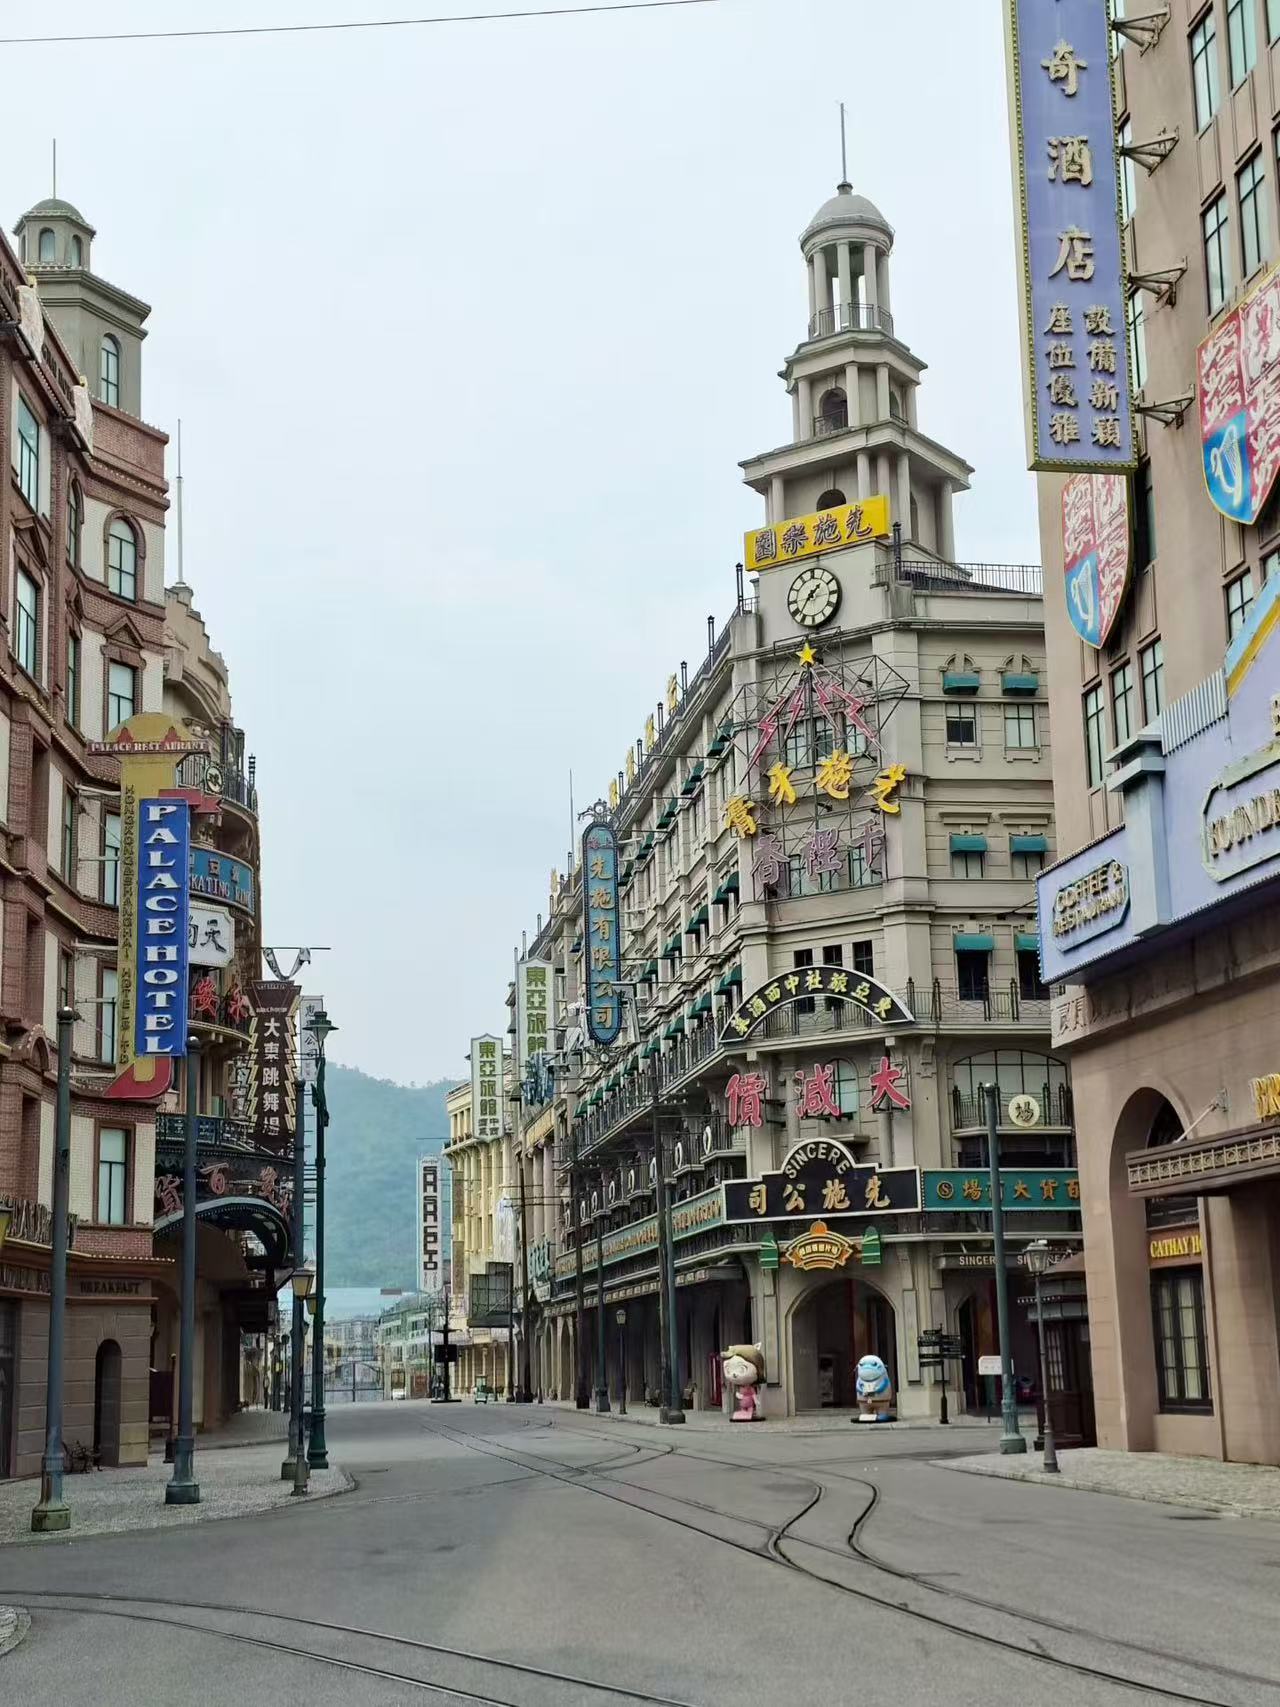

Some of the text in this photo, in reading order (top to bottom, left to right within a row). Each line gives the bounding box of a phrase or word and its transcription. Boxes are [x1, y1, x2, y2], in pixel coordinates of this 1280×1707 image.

[1043, 300, 1081, 446] 座位優雅
[1056, 862, 1123, 913] COFFEE &
[143, 805, 180, 1053] PALACE HOTEL
[589, 855, 615, 1029] 先施有限公司
[725, 1056, 912, 1128] 大減價
[784, 1143, 850, 1179] SINCERE
[748, 1175, 891, 1215] 先施公司
[959, 1255, 997, 1266] SINCER
[1150, 1235, 1189, 1258] CATHAY
